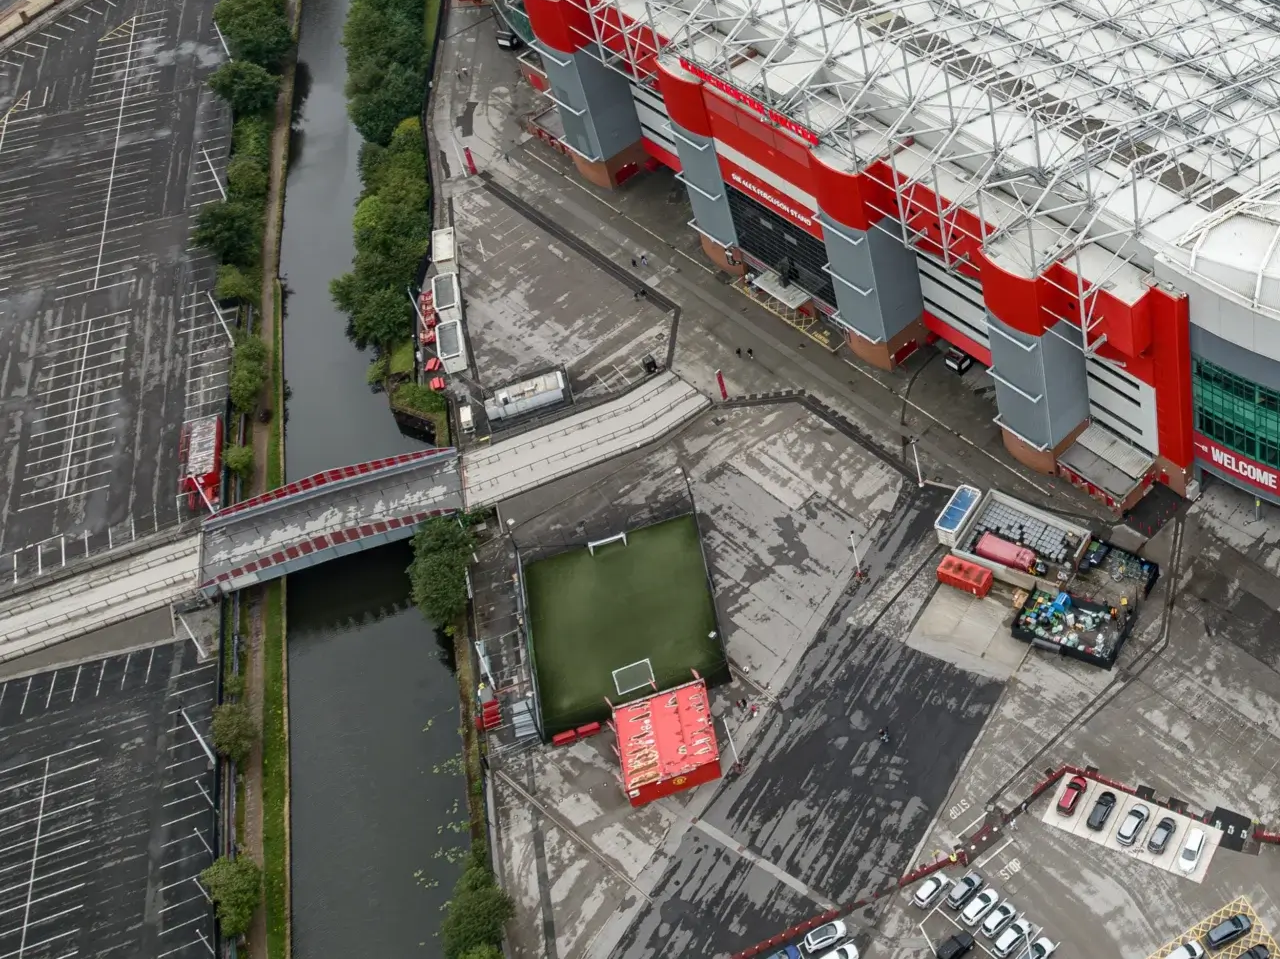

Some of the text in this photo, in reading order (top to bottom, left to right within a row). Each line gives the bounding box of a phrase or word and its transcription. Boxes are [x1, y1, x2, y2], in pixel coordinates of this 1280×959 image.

[789, 209, 812, 226] STAND
[1211, 446, 1277, 490] WELCOME
[949, 799, 970, 820] STOP
[999, 858, 1021, 880] STOP
